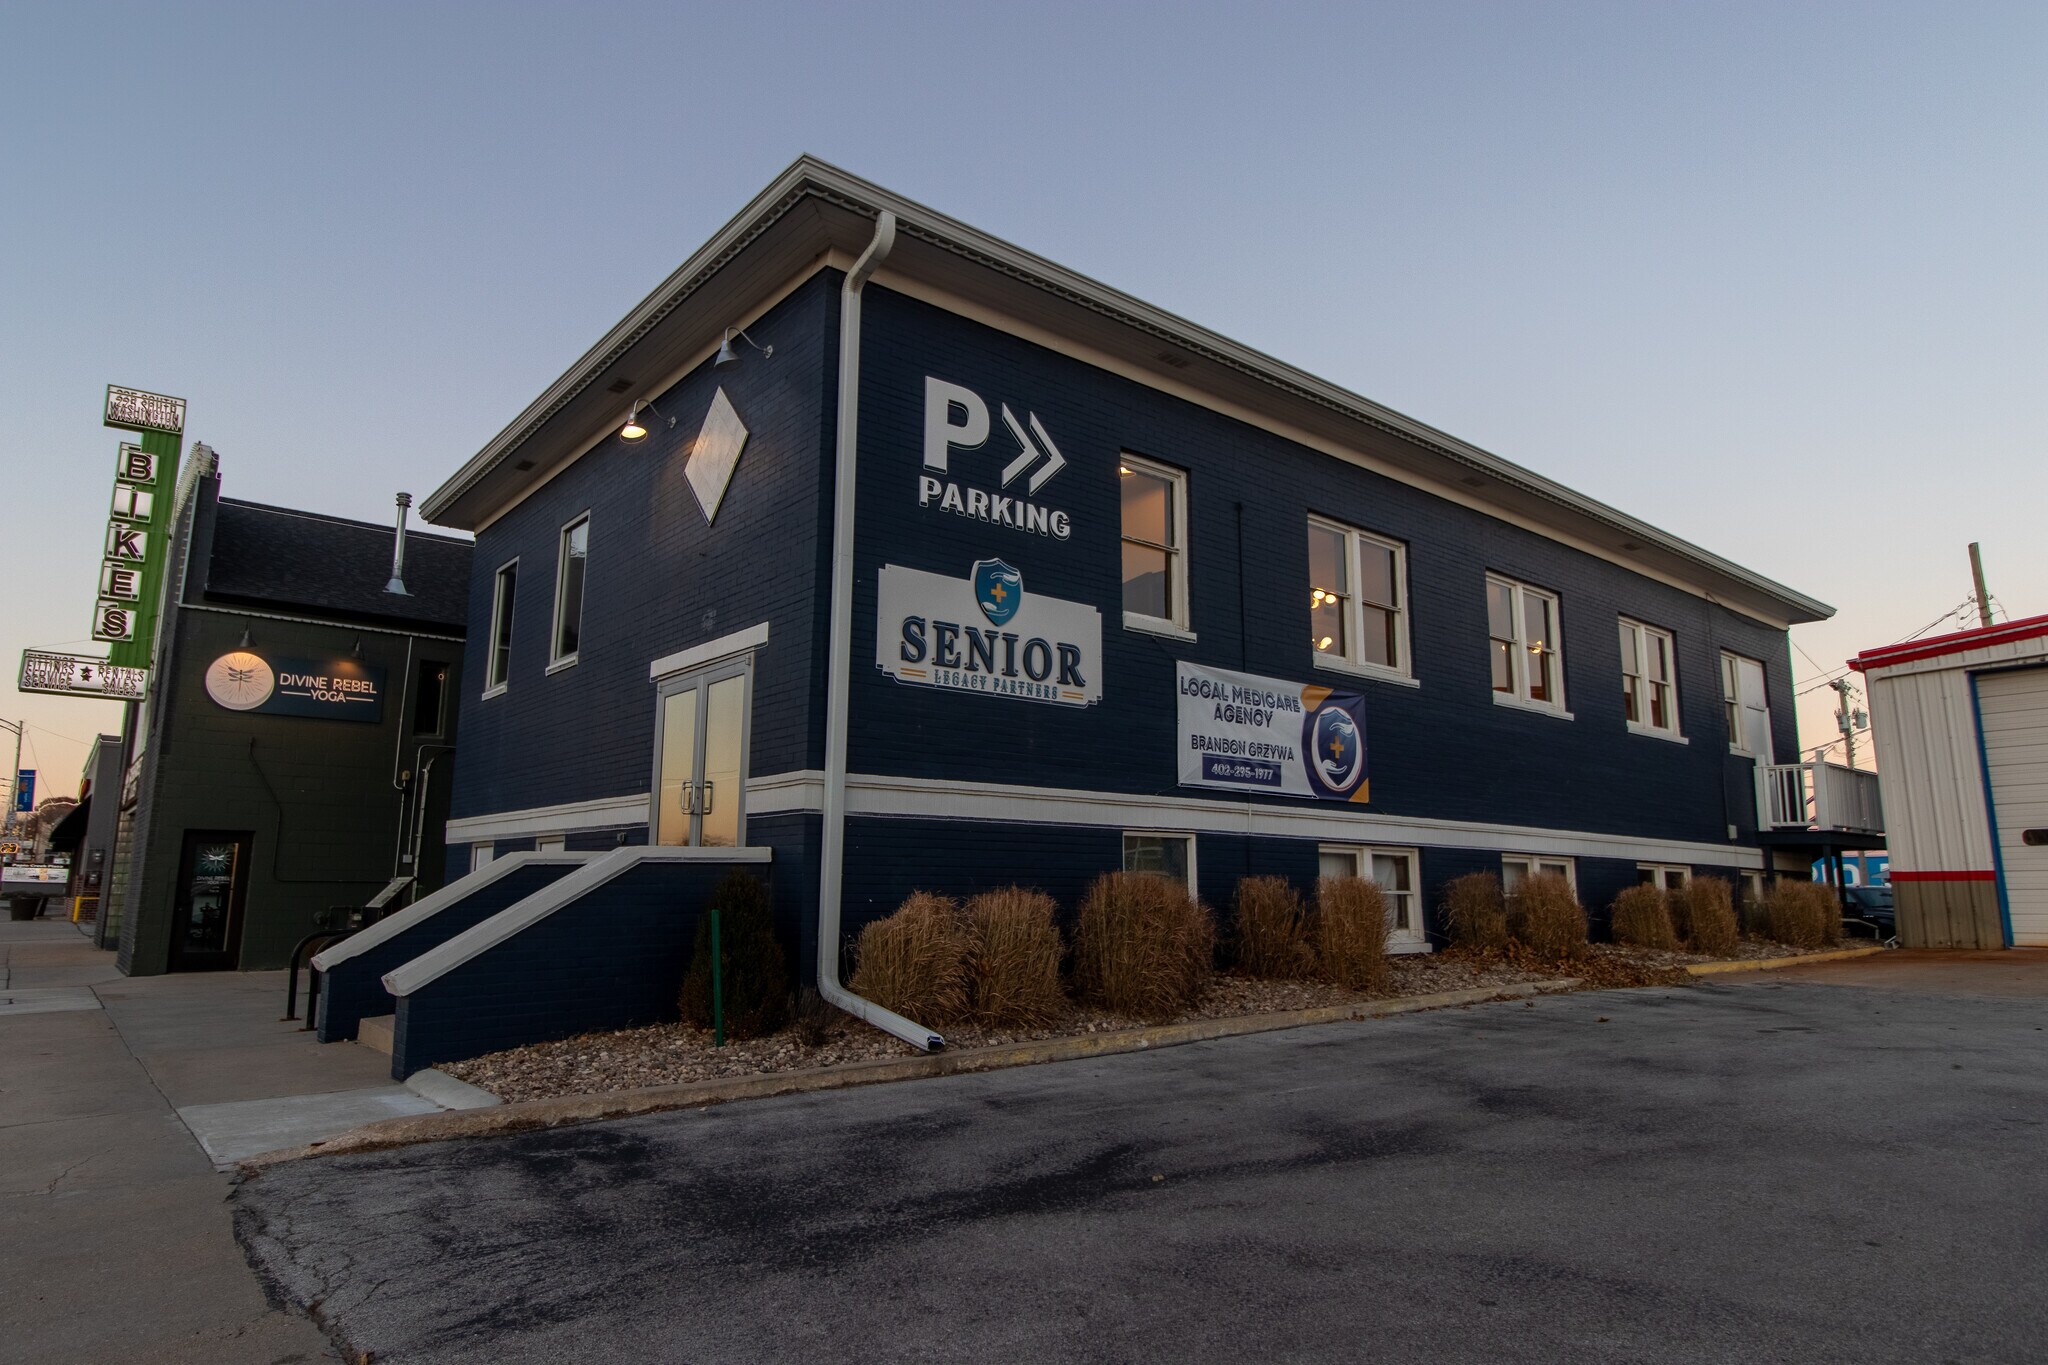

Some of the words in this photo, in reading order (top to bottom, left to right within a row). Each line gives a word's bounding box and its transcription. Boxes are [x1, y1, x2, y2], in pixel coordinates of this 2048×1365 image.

[110, 401, 179, 431] WASHINGTON
[141, 394, 178, 416] SOUTH
[923, 376, 990, 474] P
[918, 475, 1071, 541] PARKING
[102, 453, 152, 638] BIKES
[900, 615, 1086, 688] SENIOR
[24, 669, 72, 691] SERVICE
[102, 677, 138, 696] SALES
[26, 654, 75, 676] FITTINGS
[98, 661, 144, 683] RENTALS
[280, 673, 328, 690] DIVINE
[333, 678, 378, 694] REBEL
[310, 689, 346, 703] YOGA
[934, 669, 987, 690] LEGACY
[993, 677, 1058, 700] PARTNERS
[1180, 676, 1229, 702] LOCAL
[1232, 685, 1301, 713] MEDICARE
[1214, 703, 1273, 728] AGENCY
[1191, 734, 1246, 756] BRANDON
[1249, 741, 1295, 761] GRZYWA
